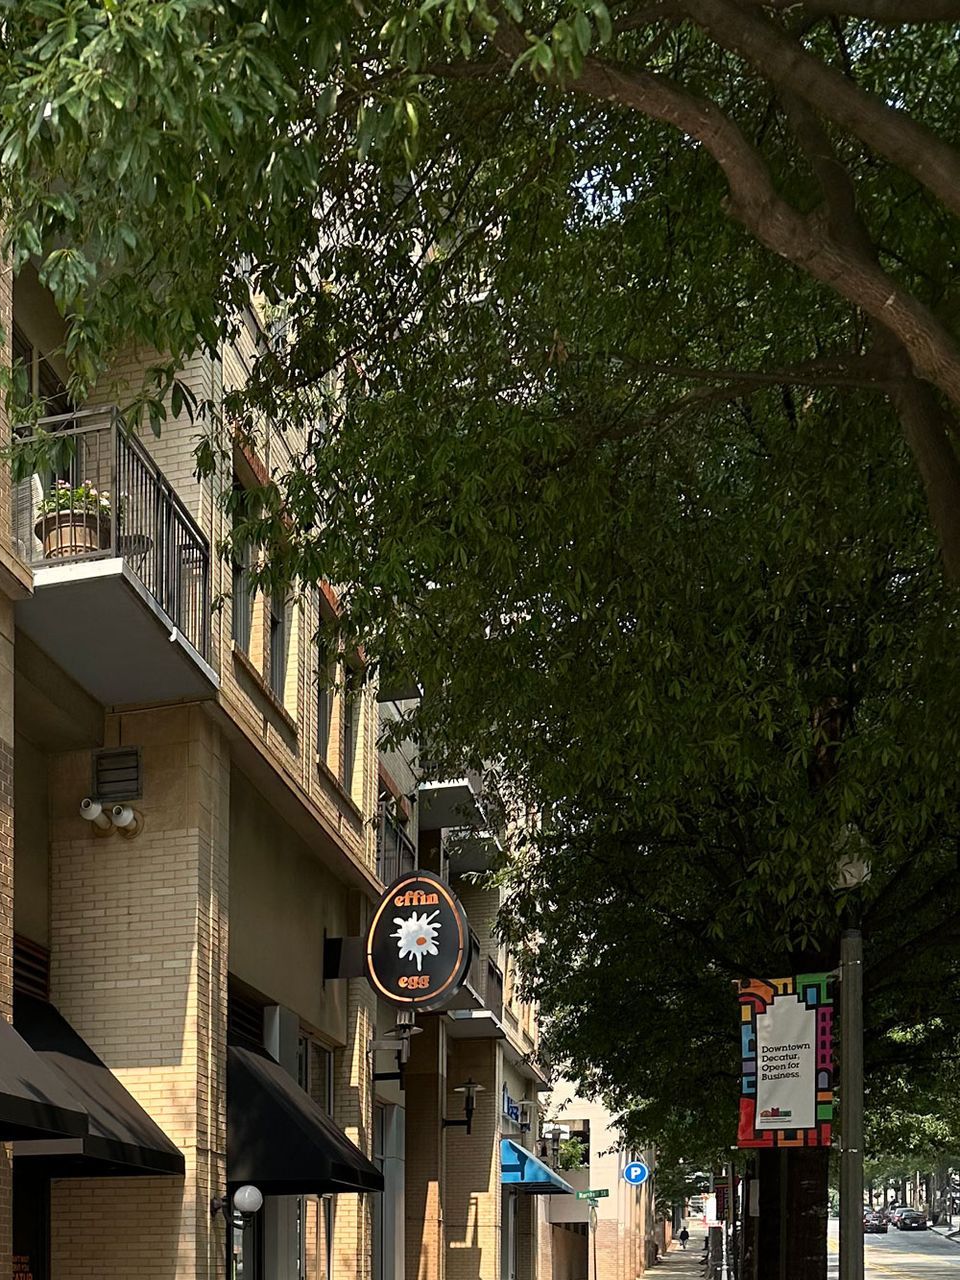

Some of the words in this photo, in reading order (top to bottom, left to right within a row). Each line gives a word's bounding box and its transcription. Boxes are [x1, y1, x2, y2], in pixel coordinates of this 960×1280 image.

[394, 890, 439, 906] effin
[398, 975, 430, 989] egg
[761, 1043, 810, 1053] Downtown
[761, 1063, 786, 1072] Open
[787, 1061, 800, 1069] for
[630, 1167, 642, 1179] P
